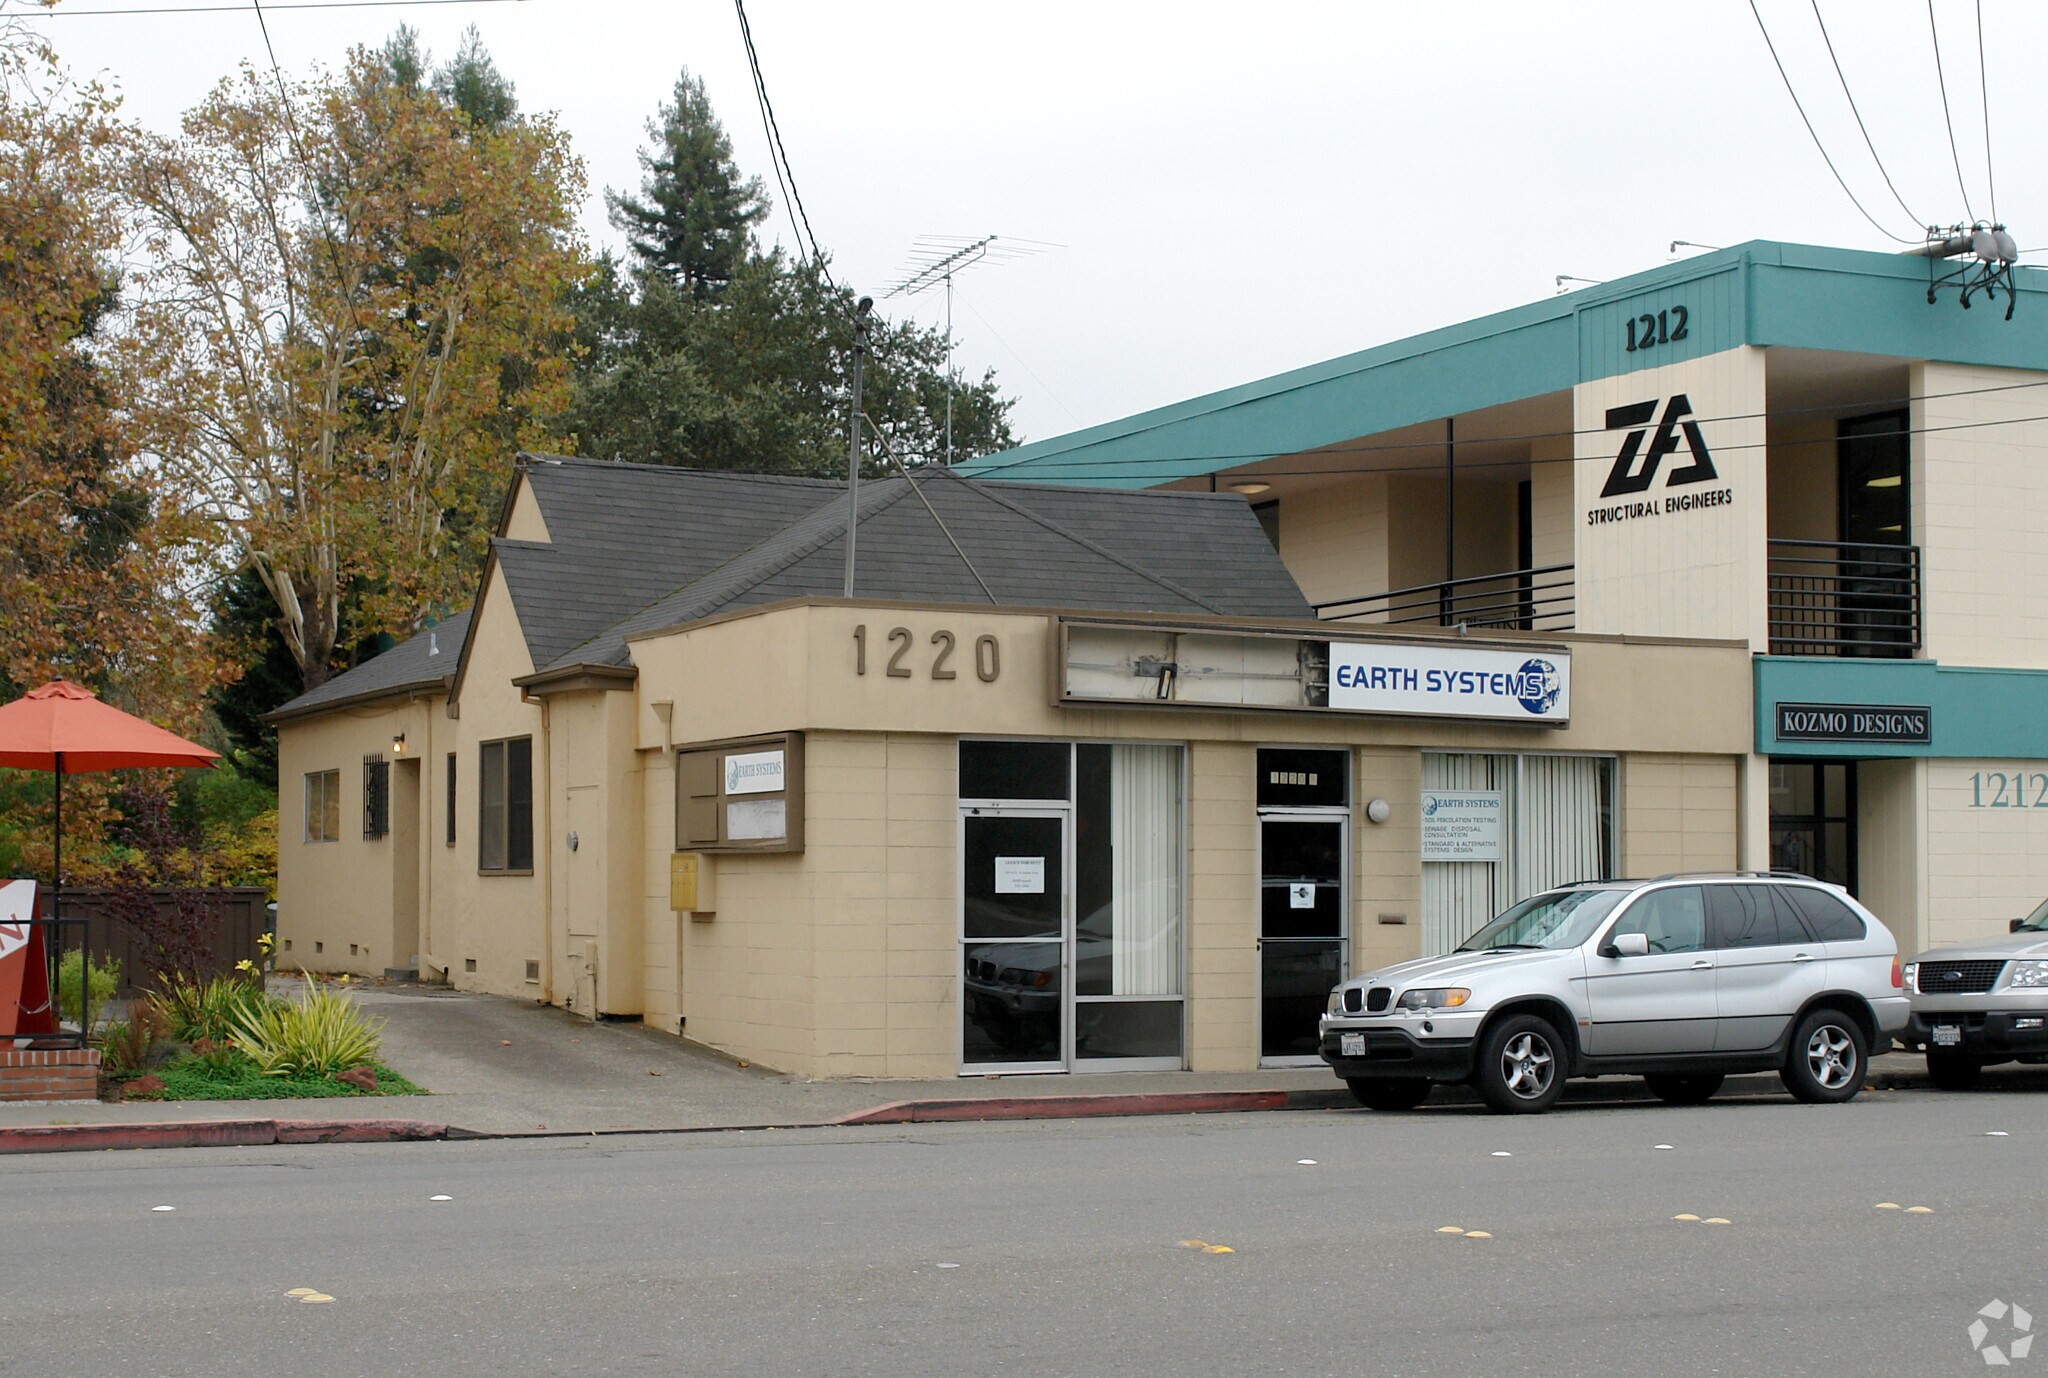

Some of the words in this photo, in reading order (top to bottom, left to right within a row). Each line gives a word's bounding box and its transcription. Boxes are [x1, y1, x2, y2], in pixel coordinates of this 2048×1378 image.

[1626, 305, 1689, 352] 1212
[1587, 499, 1660, 526] STRUCTURAL
[1665, 488, 1733, 513] ENGINEERS
[853, 624, 1001, 683] 1220
[1336, 664, 1418, 691] EARTH
[1426, 669, 1544, 698] SYSTEMS
[1783, 711, 1847, 733] KOZMO
[1853, 713, 1925, 735] DESIGNS
[739, 764, 755, 777] EARTH
[756, 762, 781, 775] SYSTEMS
[1438, 799, 1464, 808] EARTH
[1465, 799, 1499, 808] SYSTEMS
[1967, 771, 2048, 808] 1212
